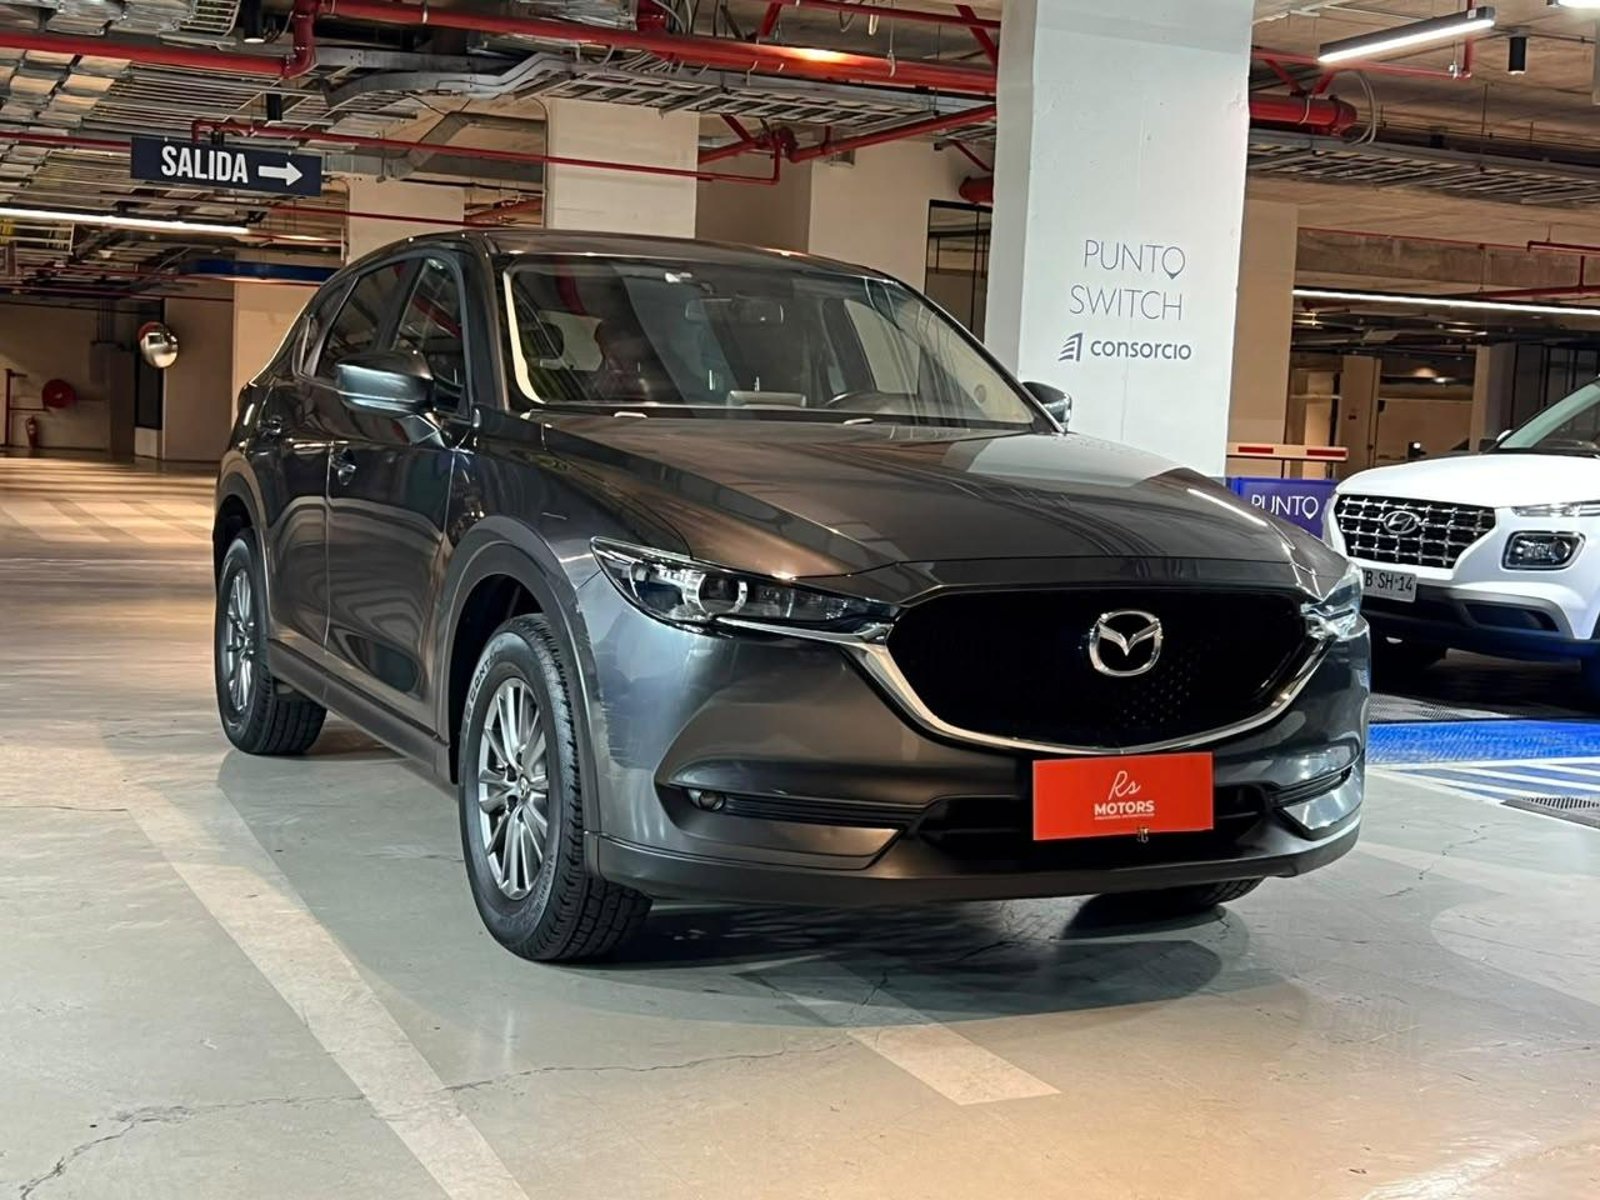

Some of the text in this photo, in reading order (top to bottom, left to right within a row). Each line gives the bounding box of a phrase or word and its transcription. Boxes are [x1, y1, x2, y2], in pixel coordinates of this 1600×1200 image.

[161, 145, 249, 184] SALIDA
[1084, 239, 1186, 280] PUNTO
[1069, 284, 1183, 321] SWITCH
[1090, 340, 1192, 361] consorcio
[1251, 494, 1319, 520] PUNTO
[1107, 770, 1142, 801] Rs
[1094, 800, 1155, 816] MOTORS
